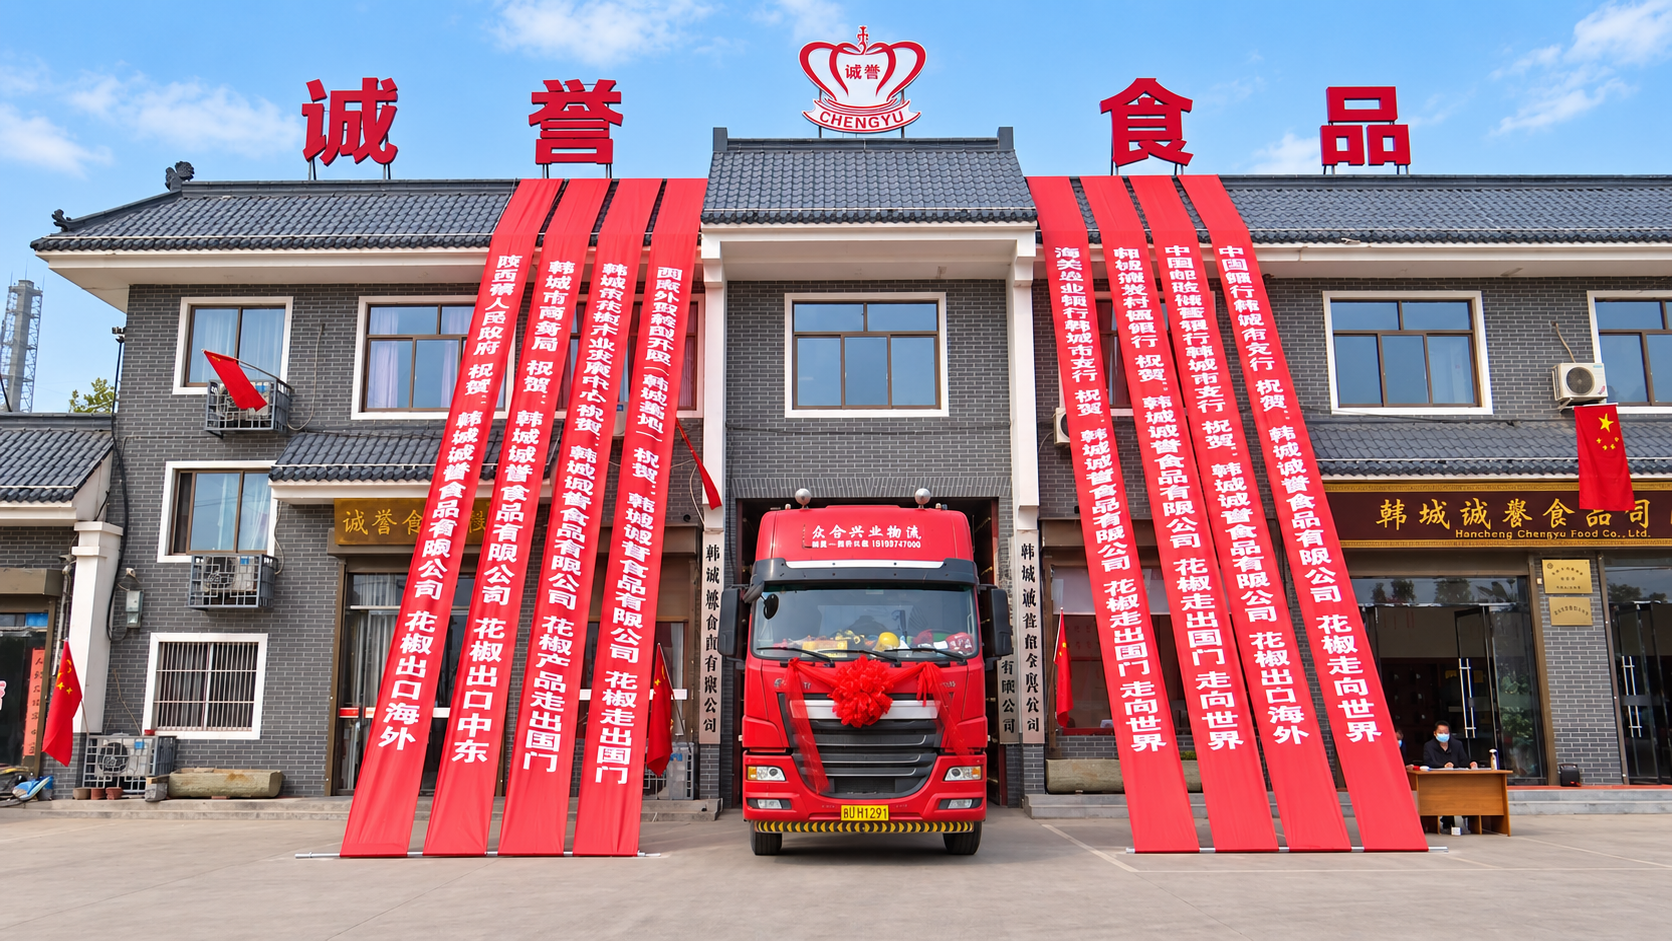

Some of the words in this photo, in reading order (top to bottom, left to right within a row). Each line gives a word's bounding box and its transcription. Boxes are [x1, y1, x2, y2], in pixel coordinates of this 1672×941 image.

[820, 111, 904, 129] CHENGYU
[845, 64, 881, 80] 诚誉
[812, 524, 922, 540] 众合兴业物流
[1570, 529, 1599, 538] Food
[377, 611, 438, 751] 花椒出口海外
[451, 617, 507, 765] 花椒出口中东
[523, 615, 575, 773] 花椒产品走出国门
[595, 671, 638, 785] 花椒走出国门
[1249, 632, 1309, 745] 花椒出口海外
[1316, 615, 1382, 743] 花椒走向世界
